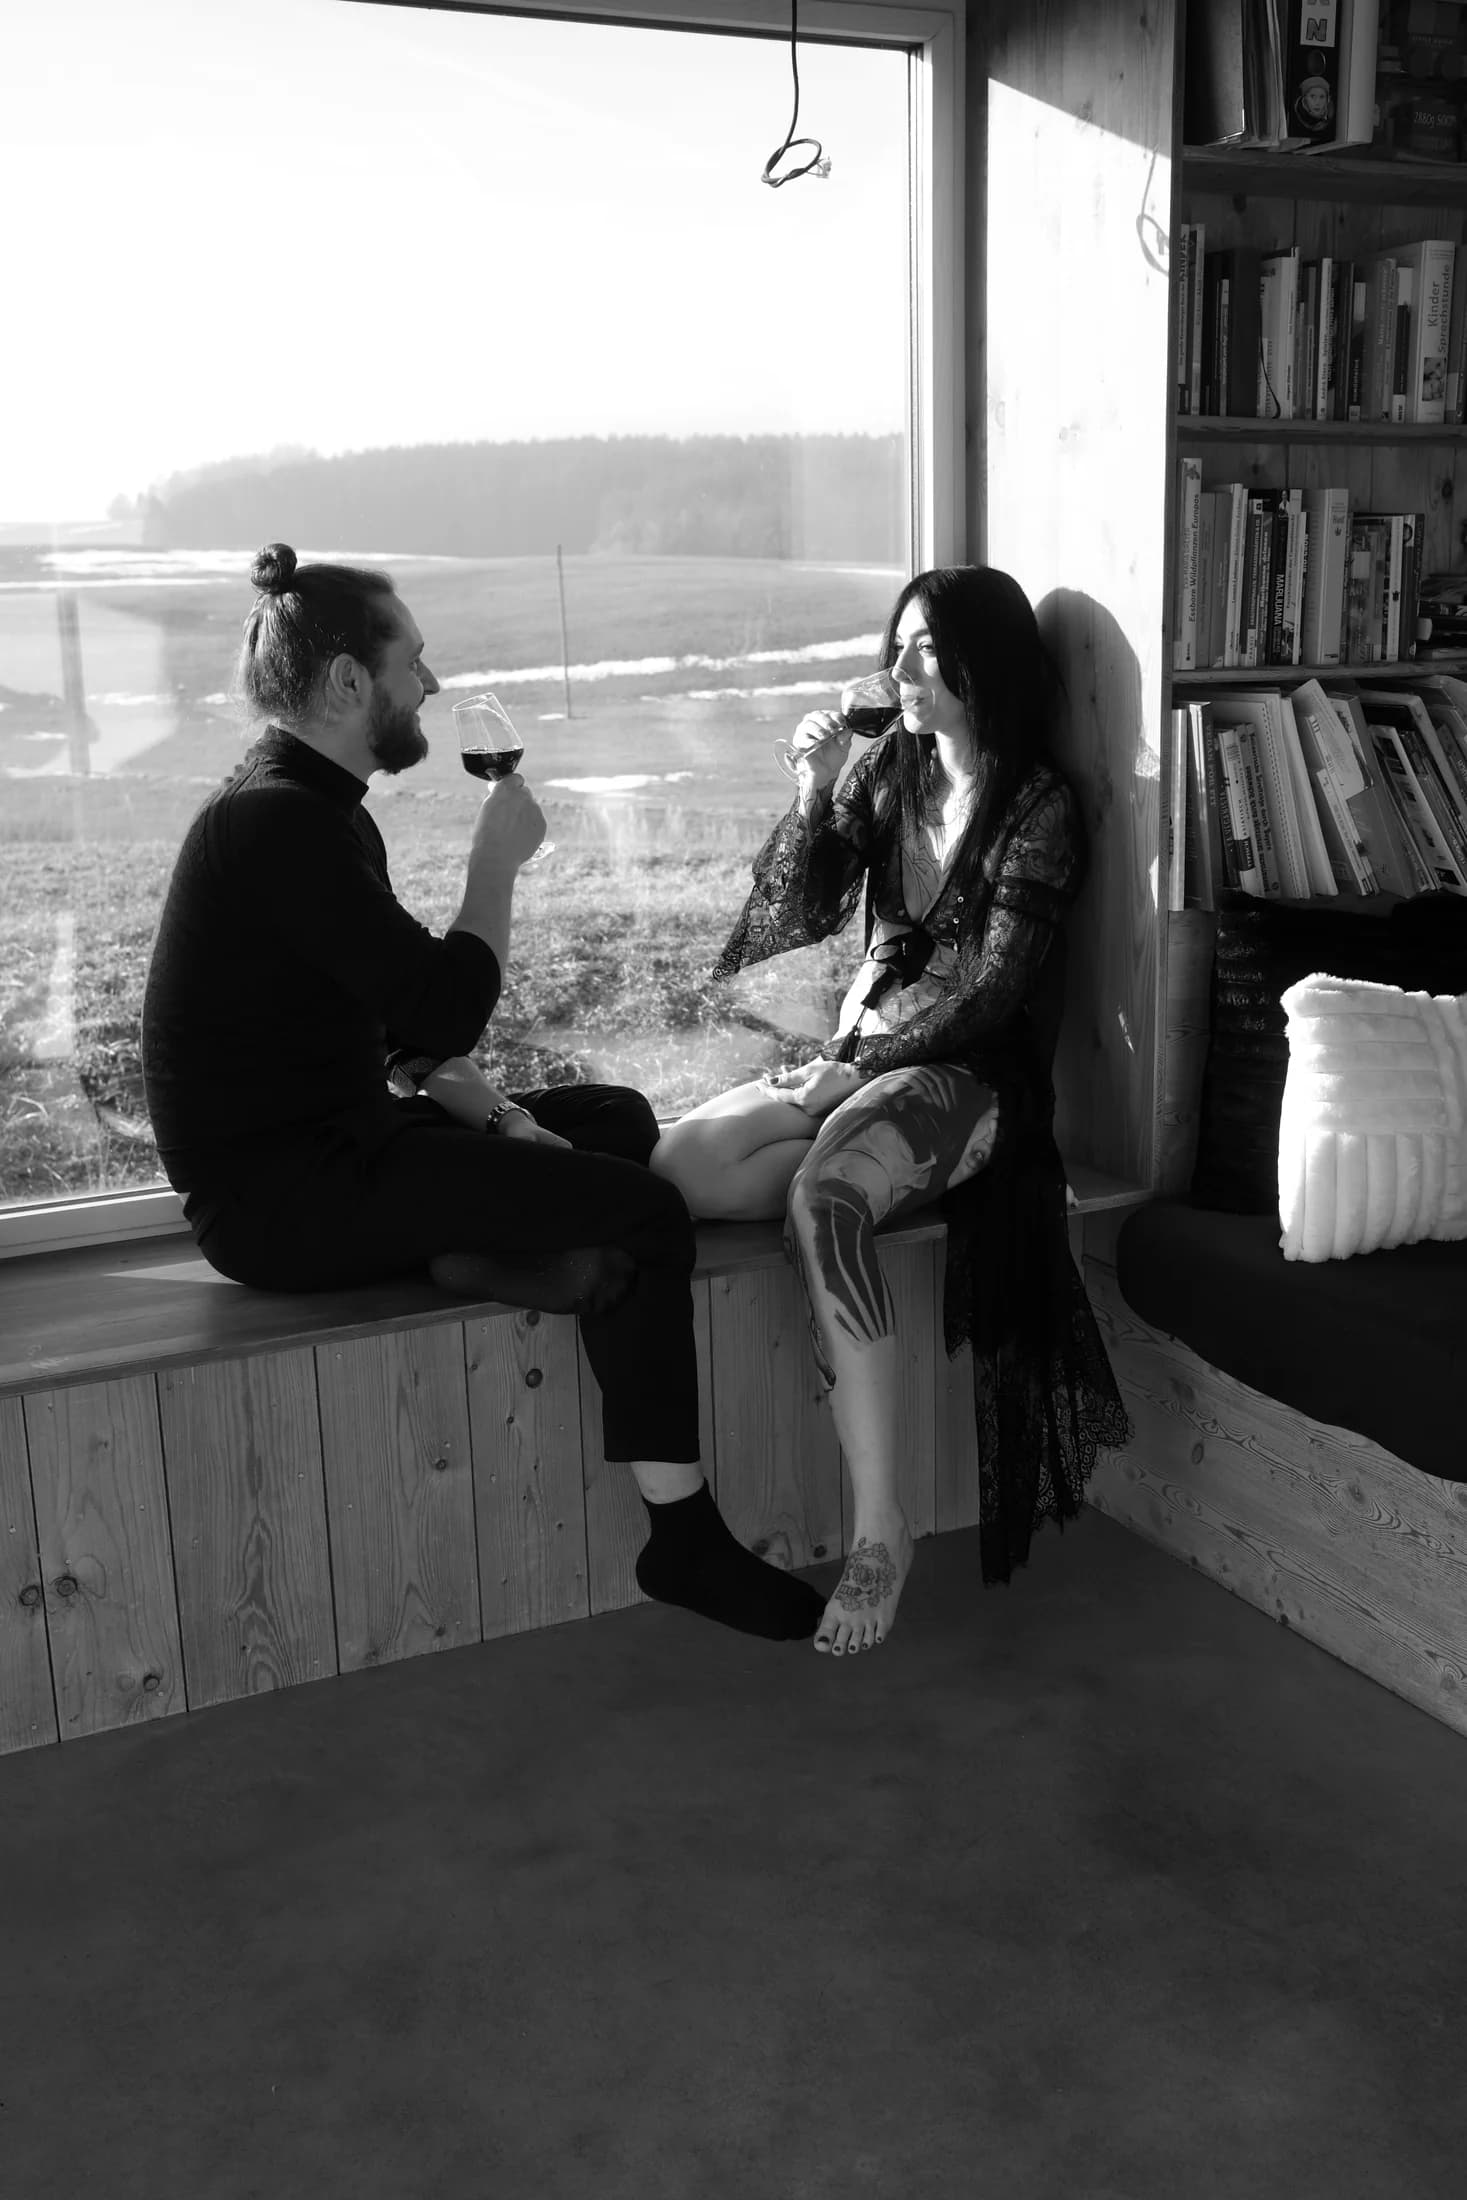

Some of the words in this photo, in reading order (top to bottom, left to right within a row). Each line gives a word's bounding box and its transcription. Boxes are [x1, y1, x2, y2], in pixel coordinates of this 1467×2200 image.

[1427, 281, 1440, 328] Kinder
[1438, 264, 1450, 354] Sprechstunde
[1191, 494, 1200, 529] Europas
[1189, 530, 1199, 586] Wildpflanzen
[1188, 589, 1196, 622] Essbare
[1274, 574, 1285, 625] MARIJUANA
